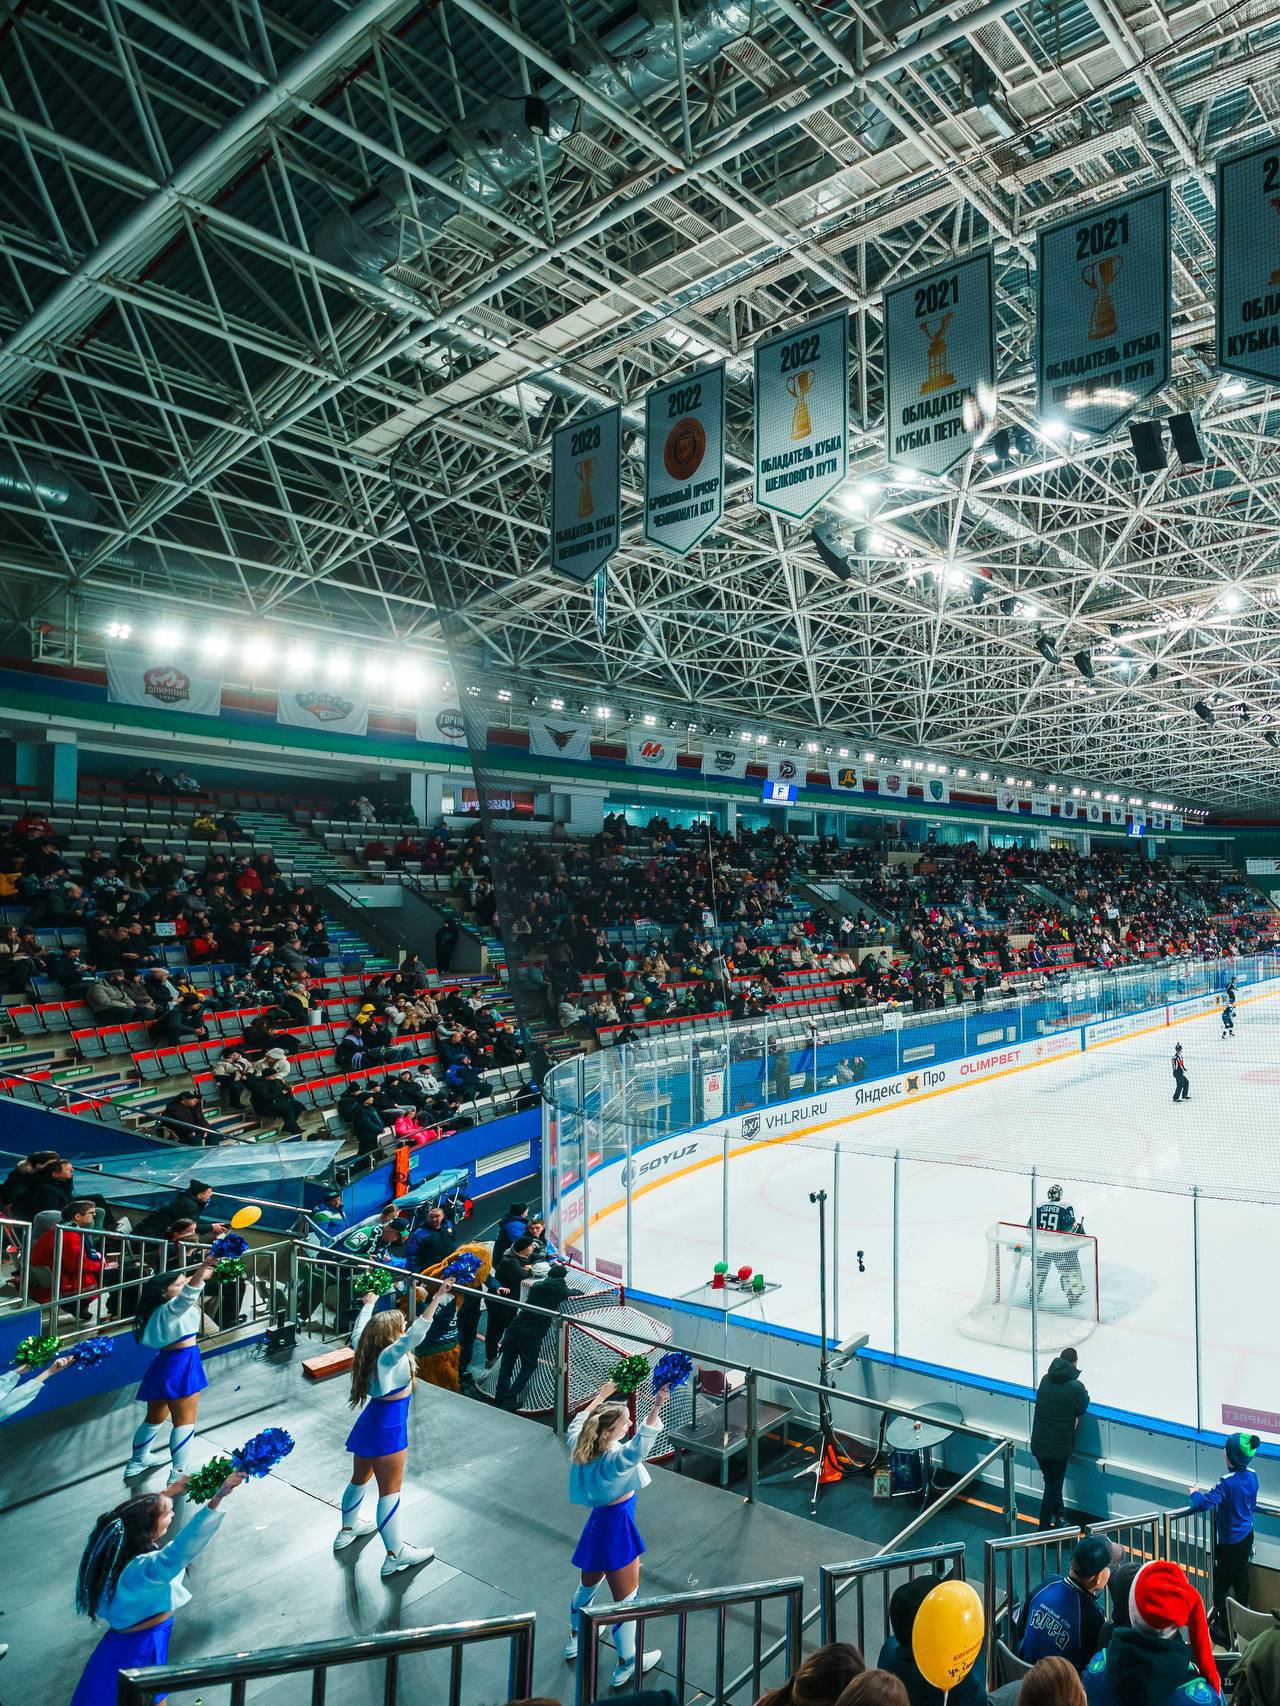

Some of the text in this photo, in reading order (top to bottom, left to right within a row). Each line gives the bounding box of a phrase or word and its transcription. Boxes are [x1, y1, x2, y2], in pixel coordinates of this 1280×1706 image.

[1076, 212, 1129, 261] 2021
[915, 275, 959, 319] 2021
[780, 334, 821, 373] 2022
[1046, 332, 1161, 381] ОБЛАДАТЕЛЬ КУБКА
[1228, 324, 1280, 357] КУБКА
[668, 384, 702, 417] 2022
[571, 425, 600, 456] 2023
[761, 435, 842, 473] ОБЛАДАТЕЛЬ КУБКА
[896, 427, 931, 454] КУБКА
[766, 457, 837, 492] ШЕЛКОВОГО ПУТИ
[778, 787, 784, 796] F
[960, 1050, 1021, 1076] OLIMPBET
[855, 1071, 945, 1105] Яндекс Про
[766, 1103, 827, 1129] VHLRU.RU
[639, 1143, 698, 1176] SOYUZ
